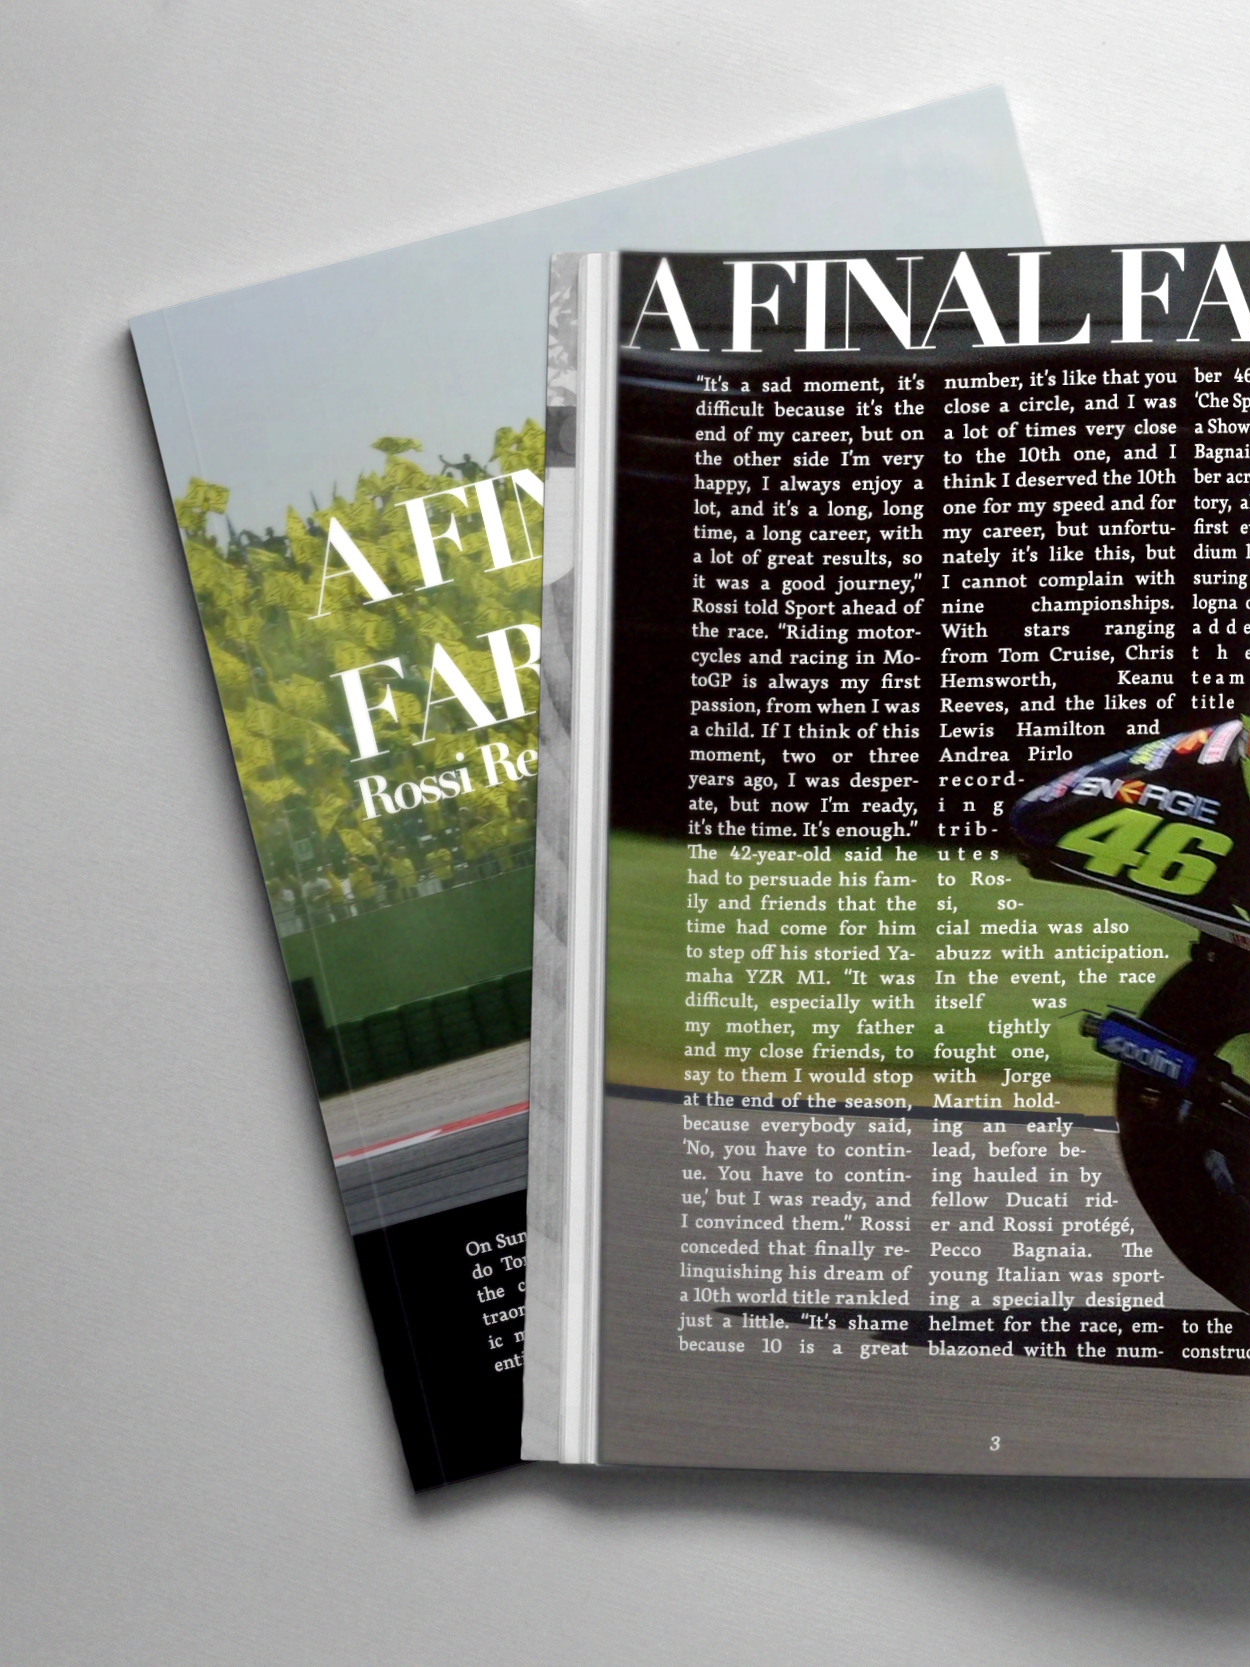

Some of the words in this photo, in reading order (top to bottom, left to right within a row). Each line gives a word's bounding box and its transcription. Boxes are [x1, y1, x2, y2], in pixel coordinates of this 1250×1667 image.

[620, 257, 710, 353] A
[721, 251, 1091, 352] FINAL
[740, 381, 751, 393] a
[761, 376, 793, 393] sad
[803, 377, 885, 395] moment,
[897, 372, 925, 391] it's
[944, 371, 1023, 391] number,
[1029, 368, 1057, 387] it's
[1061, 369, 1097, 386] like
[1102, 367, 1140, 385] that
[1143, 372, 1178, 389] you
[1193, 366, 1223, 384] ber
[695, 399, 765, 417] difficult
[773, 400, 845, 417] because
[855, 398, 883, 417] it's
[893, 399, 925, 416] the
[308, 516, 403, 620] A
[940, 647, 989, 664] from
[998, 647, 1040, 663] Tom
[1049, 645, 1115, 665] Cruise,
[1125, 643, 1174, 661] Chris
[940, 670, 1057, 690] Hemsworth,
[1117, 669, 1175, 685] Keanu
[938, 745, 1010, 763] Andrea
[1027, 744, 1073, 761] Pirlo
[354, 752, 476, 821] Rossi
[687, 843, 717, 860] The
[729, 845, 831, 866] 42-year-old
[844, 845, 883, 862] said
[895, 845, 918, 862] he
[1055, 807, 1235, 896] 46
[685, 967, 734, 984] maha
[745, 969, 785, 985] YZR
[796, 969, 831, 985] M1.
[879, 973, 915, 985] was
[465, 1241, 493, 1257] On
[929, 1241, 982, 1257] Pecco
[1011, 1241, 1093, 1263] Bagnaia.
[1121, 1241, 1153, 1258] The
[472, 1263, 493, 1280] do
[477, 1286, 505, 1303] the
[488, 1335, 504, 1349] ic
[678, 1335, 745, 1353] because
[761, 1337, 783, 1354] 10
[799, 1338, 815, 1355] is
[832, 1343, 844, 1355] a
[859, 1341, 909, 1360] great
[990, 1436, 1000, 1451] 3
